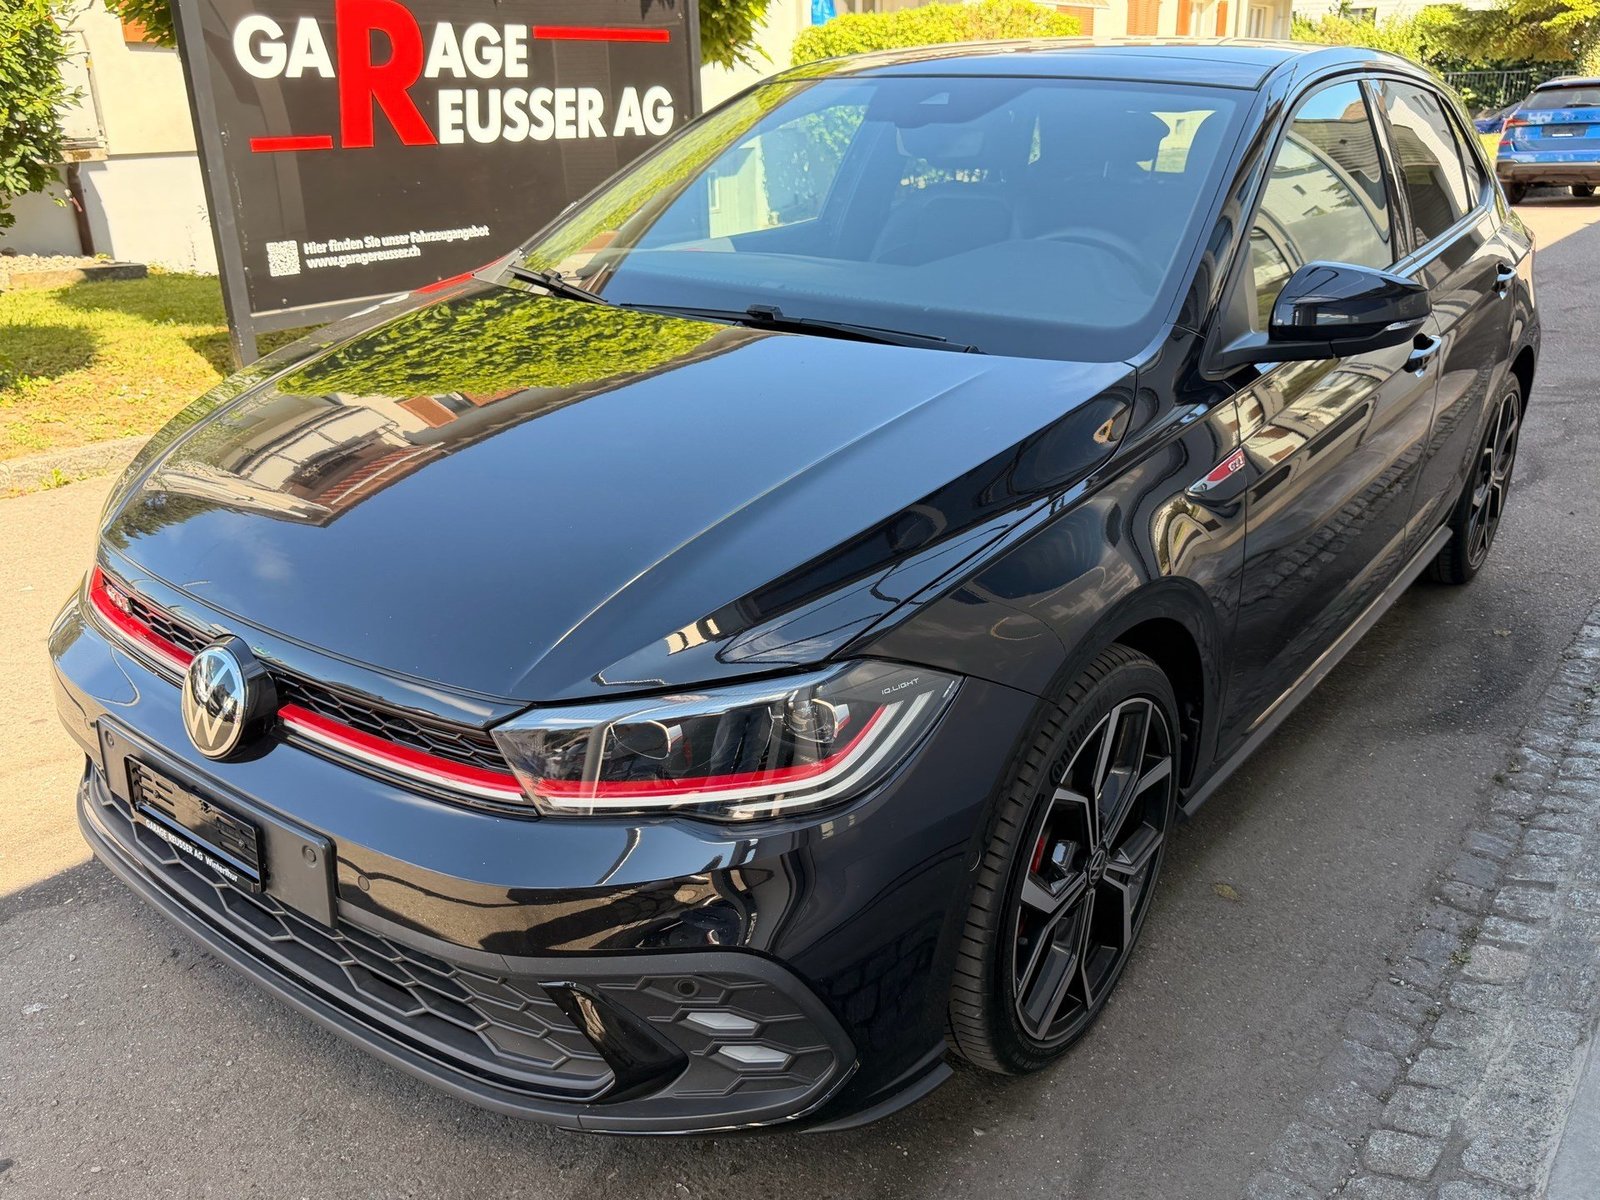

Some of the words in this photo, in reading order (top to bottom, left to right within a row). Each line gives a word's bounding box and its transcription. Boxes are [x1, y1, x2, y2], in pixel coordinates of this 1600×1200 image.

[233, 0, 529, 149] GARAGE
[612, 85, 675, 138] AG
[303, 241, 328, 255] Hier
[328, 237, 364, 253] finden
[363, 234, 381, 249] Sie
[381, 231, 410, 247] unser
[410, 225, 490, 243] Fahrzeugangebot
[305, 245, 421, 268] www.garagereusser.ch
[145, 818, 167, 839] GARAGE
[168, 832, 194, 855] REUSSER
[193, 848, 204, 862] AG
[204, 854, 239, 882] Winterthur
